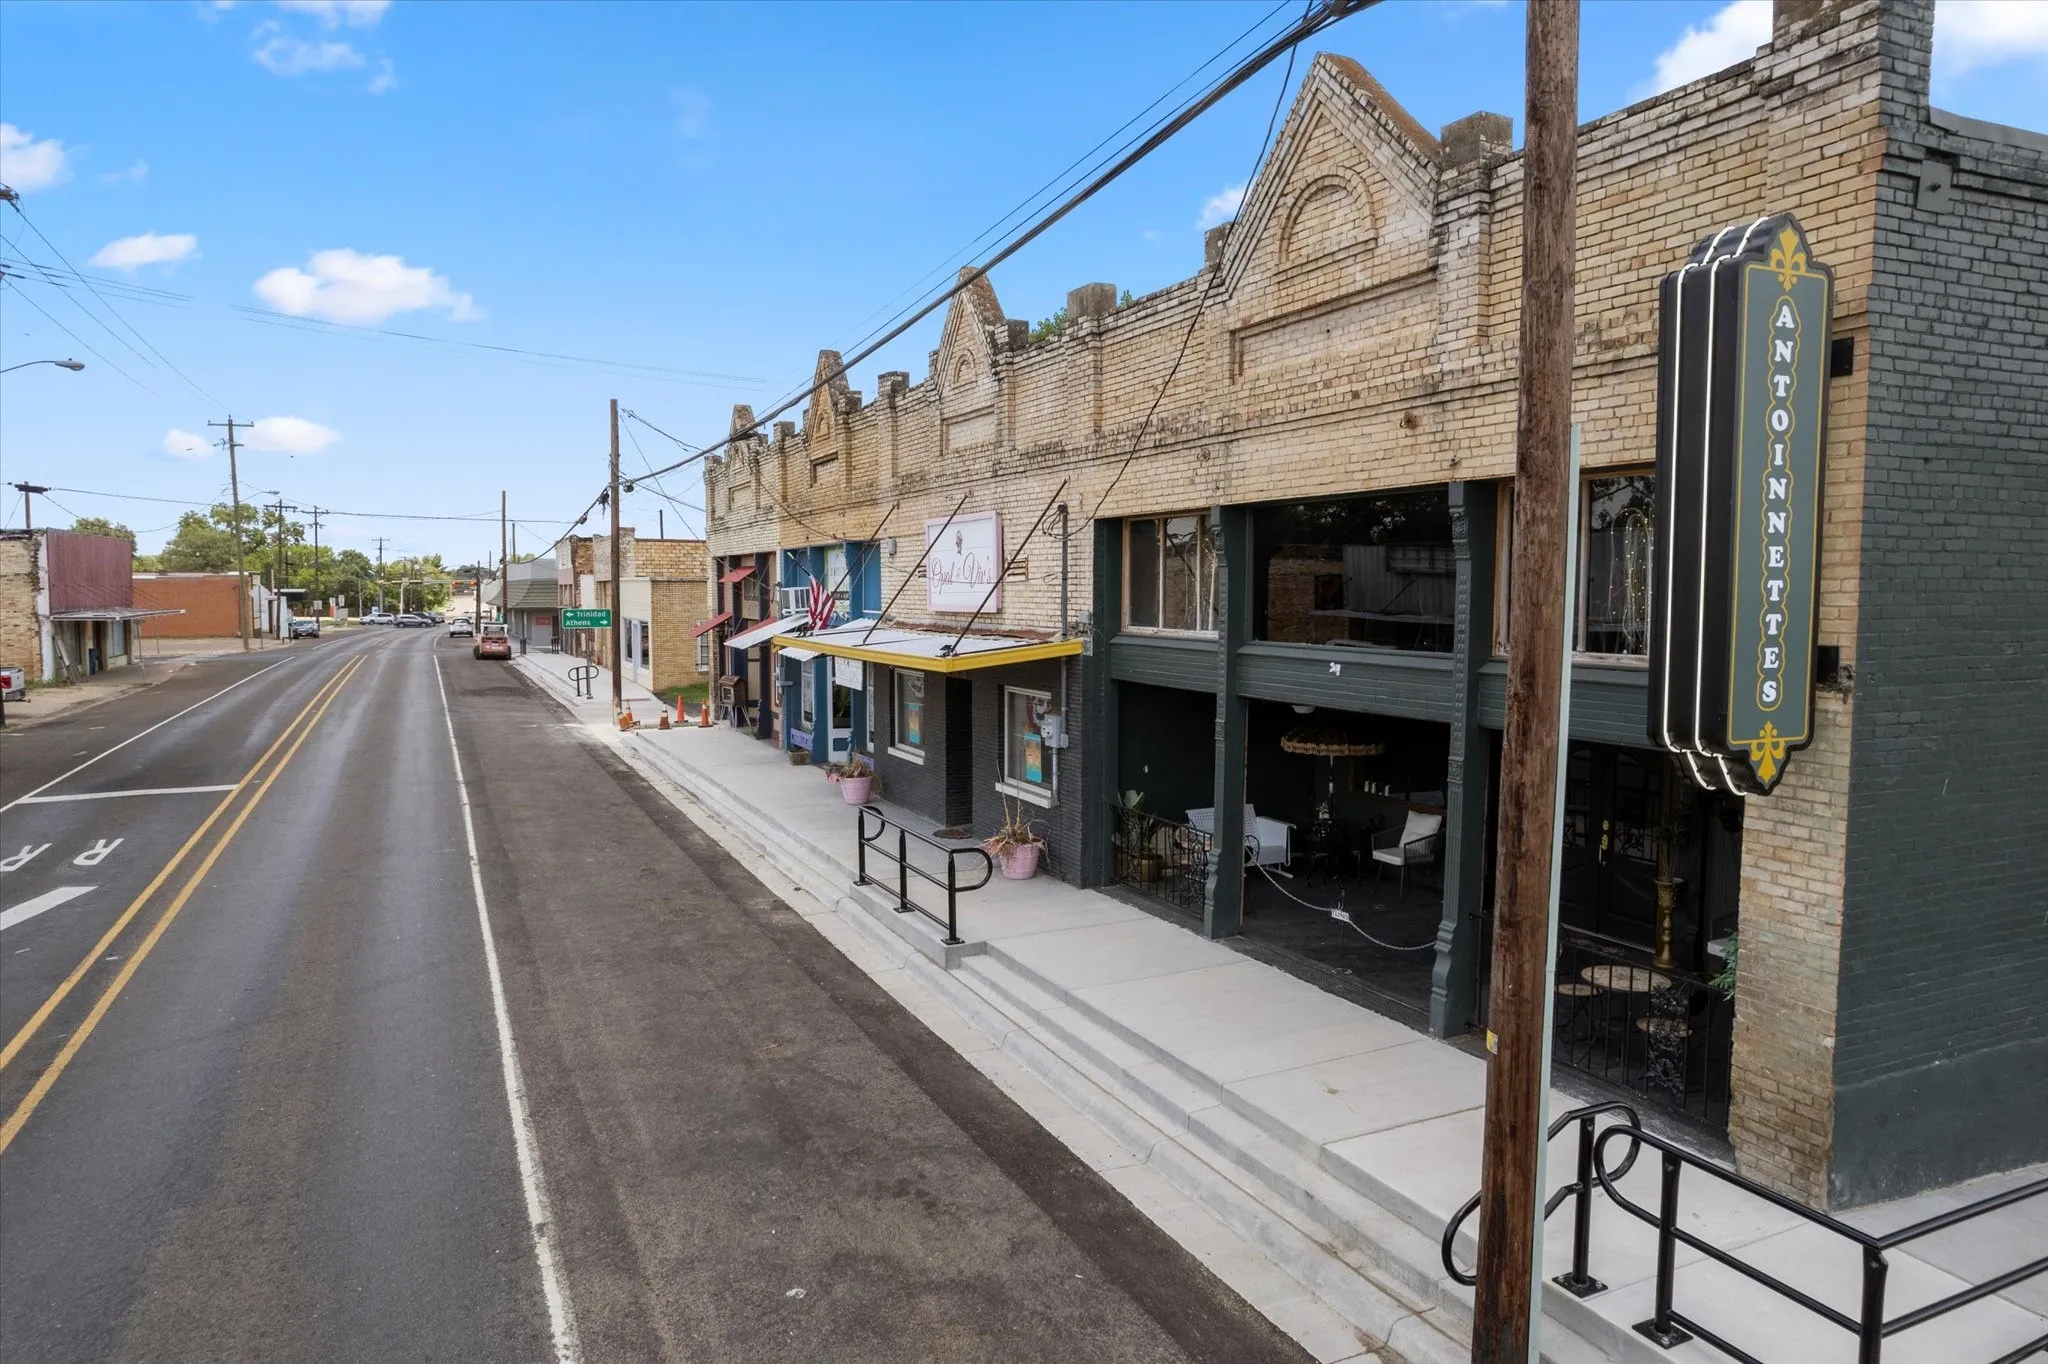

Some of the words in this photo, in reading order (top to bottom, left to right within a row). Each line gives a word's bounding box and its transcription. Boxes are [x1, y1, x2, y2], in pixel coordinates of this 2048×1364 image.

[932, 557, 955, 595] Opal
[963, 552, 993, 588] Viv's
[1762, 304, 1796, 703] ANTOINNETTES
